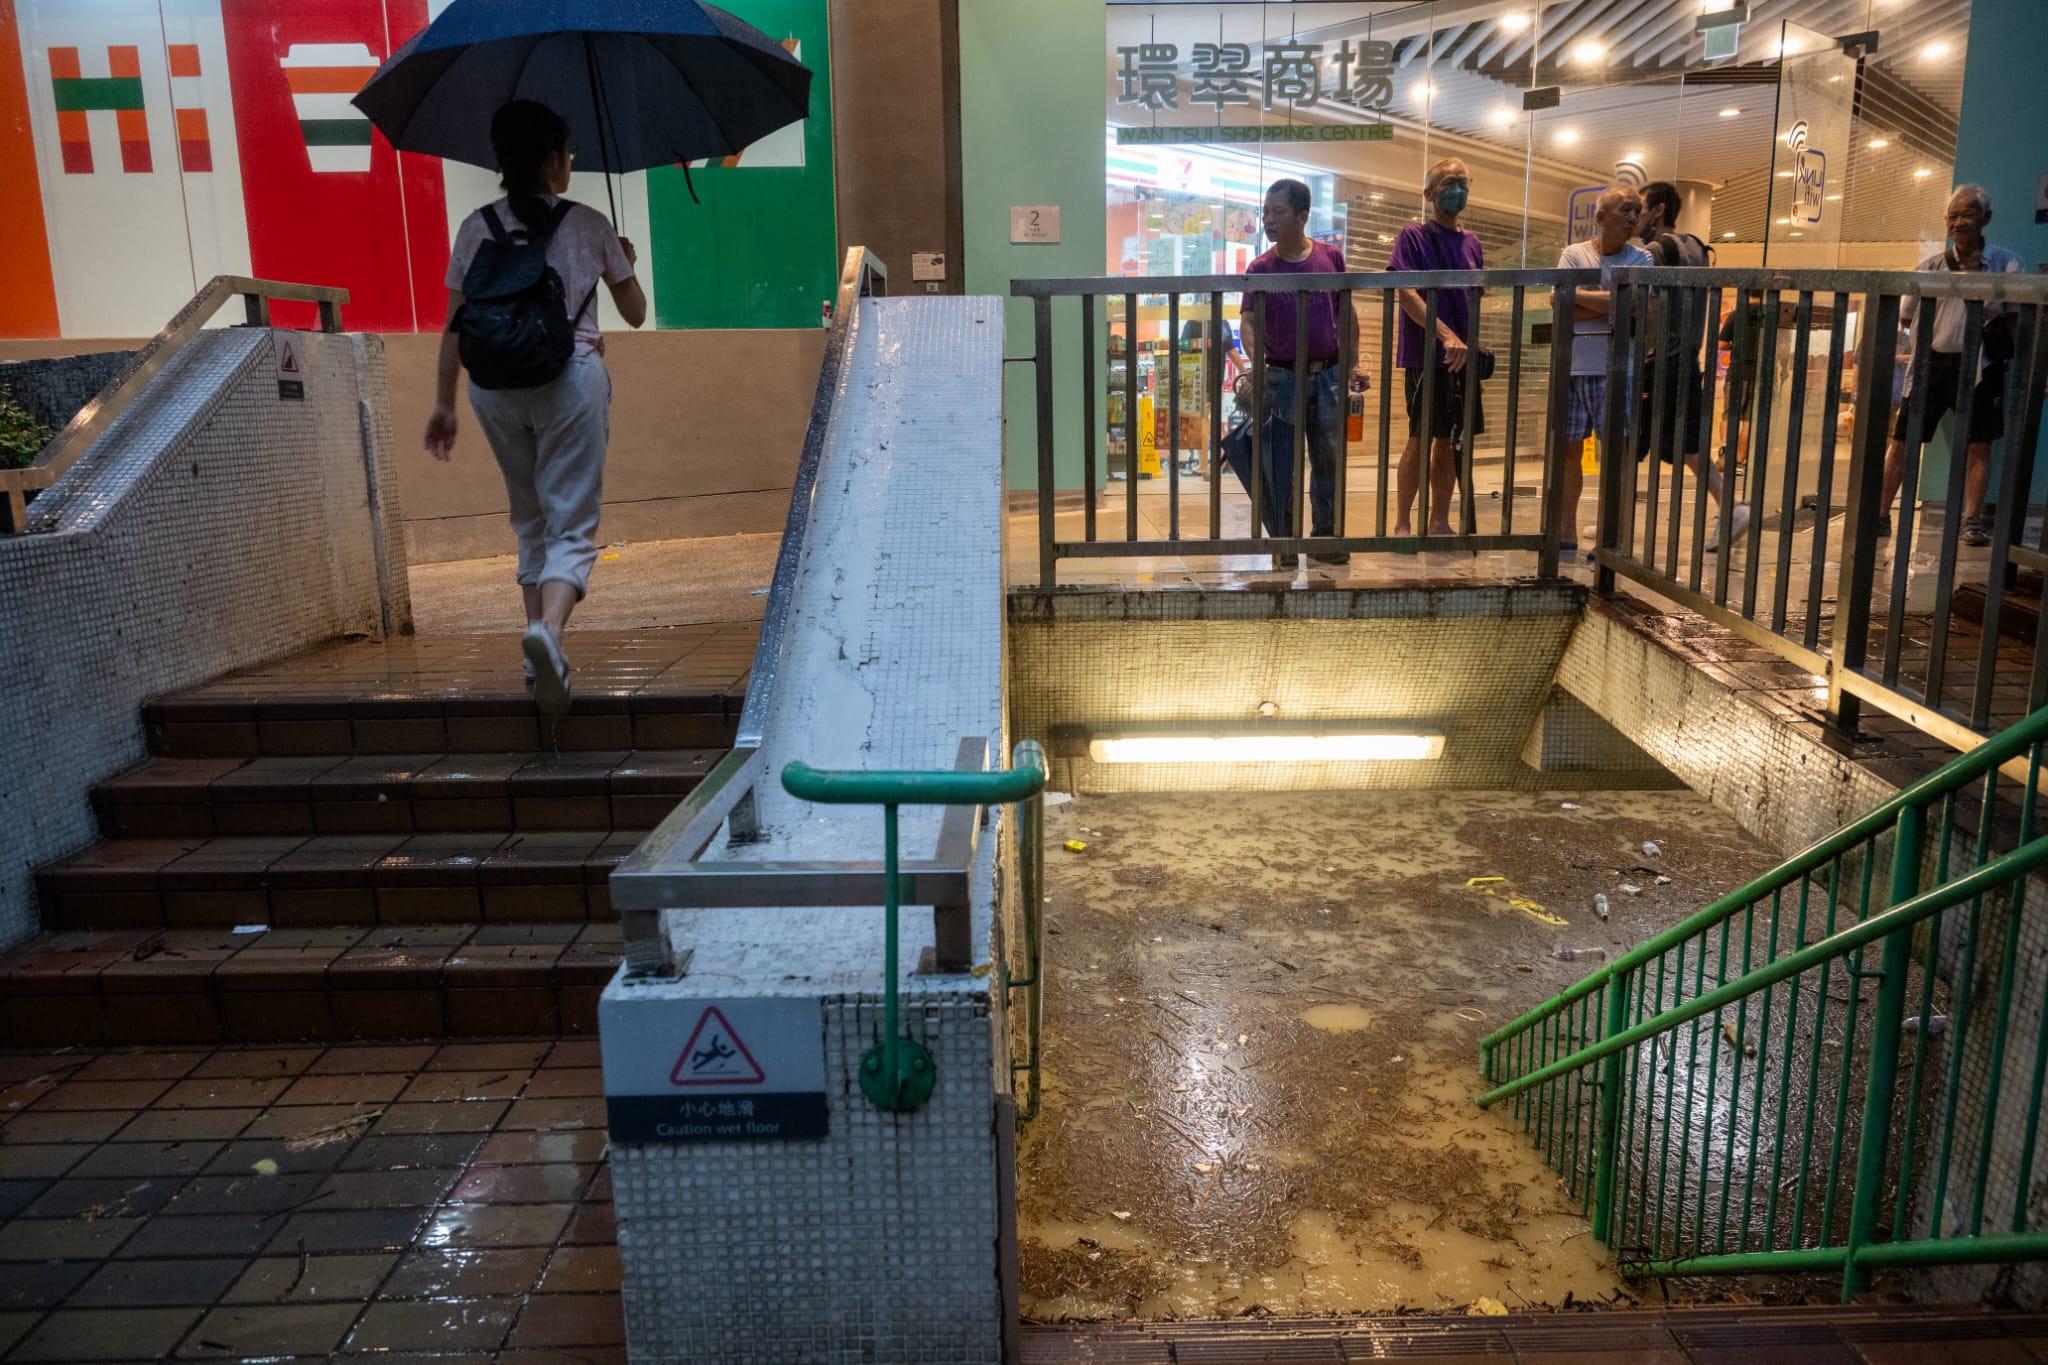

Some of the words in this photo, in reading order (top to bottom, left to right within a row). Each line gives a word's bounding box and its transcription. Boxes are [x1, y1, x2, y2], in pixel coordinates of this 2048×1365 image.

[1116, 39, 1395, 111] 環翠商場
[48, 44, 213, 174] Hi
[1118, 127, 1164, 143] WAN
[1173, 127, 1212, 142] TSUI
[1220, 126, 1314, 142] SHOPPING
[1320, 125, 1393, 141] CENTRE
[1030, 210, 1040, 226] 2
[679, 1099, 754, 1117] 小心地滑
[656, 1122, 712, 1137] Caution
[716, 1122, 742, 1135] wet
[746, 1120, 780, 1135] floor
